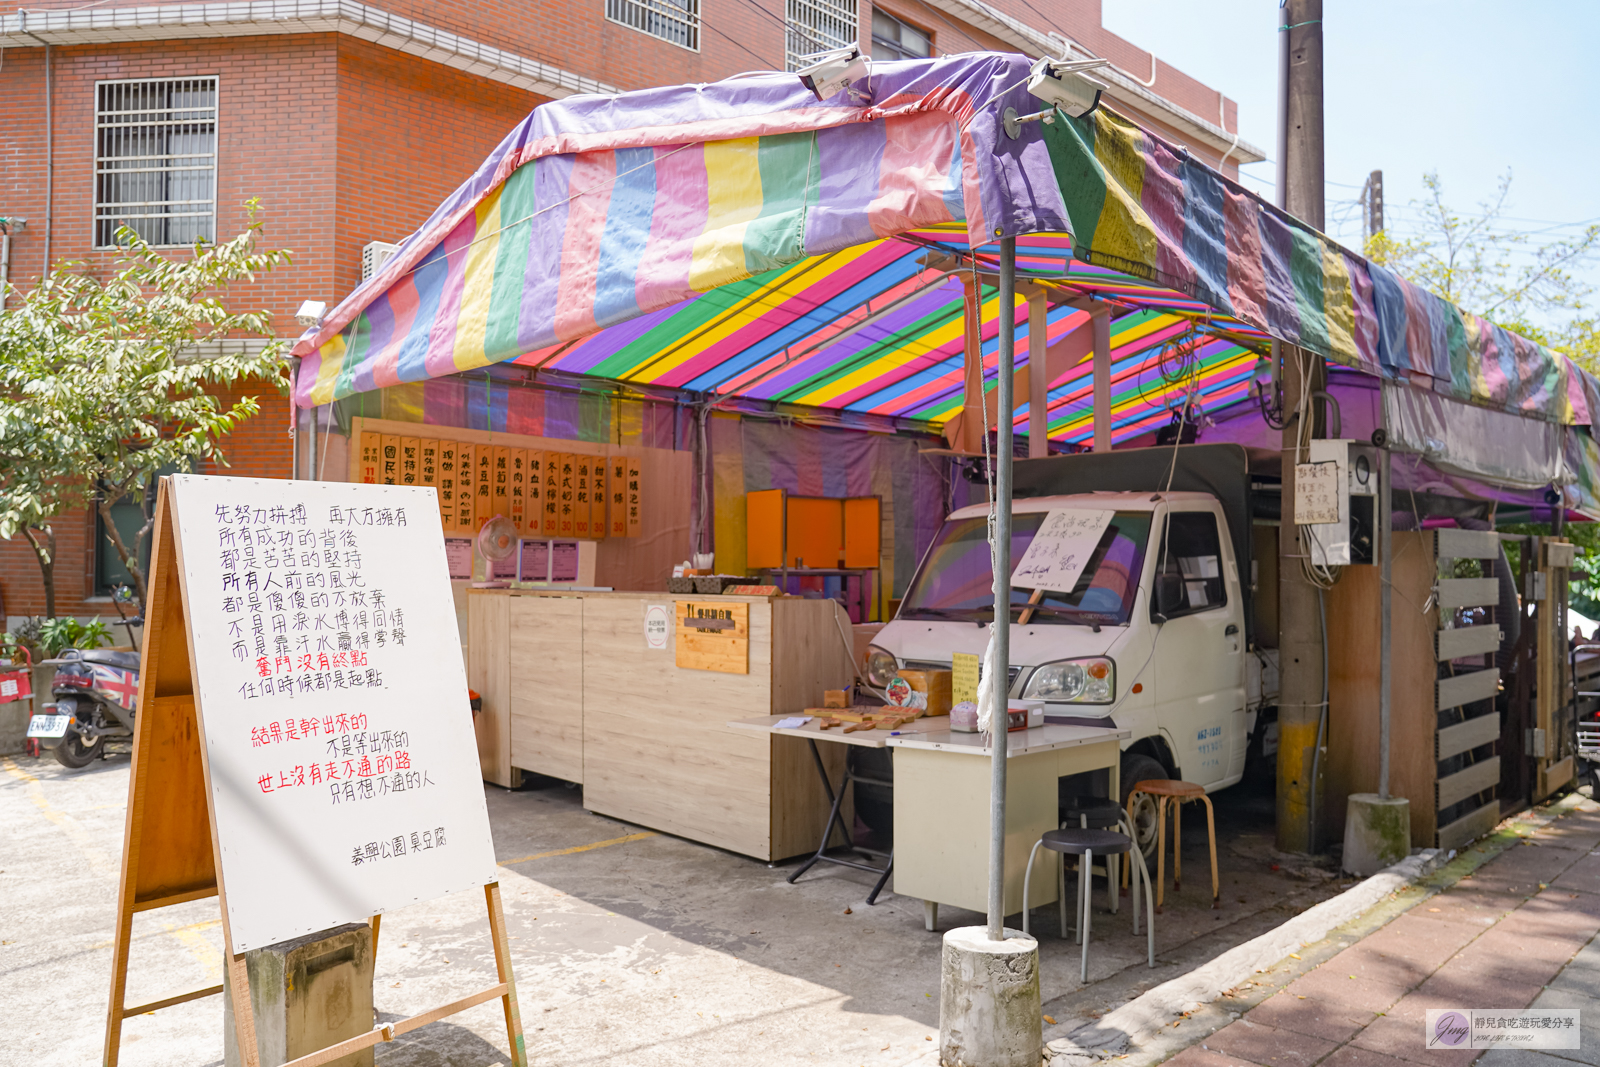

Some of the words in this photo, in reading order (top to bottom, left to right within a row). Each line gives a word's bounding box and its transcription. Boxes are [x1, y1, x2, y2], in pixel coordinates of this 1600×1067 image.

[478, 456, 489, 497] 臭豆腐
[496, 456, 507, 497] 蘿蔔糕
[513, 457, 523, 497] 魯肉飯
[530, 460, 540, 499] 豬血湯
[546, 461, 557, 514] 冬瓜檸檬
[561, 463, 572, 515] 泰式奶茶
[577, 464, 588, 503] 滷豆乾
[594, 466, 604, 504] 甜不辣
[613, 466, 624, 504] 薯條
[215, 502, 308, 526] 先努力拼搏
[329, 506, 407, 528] 再大方擁有
[529, 520, 539, 529] 40
[546, 520, 556, 530] 30
[562, 521, 572, 531] 30
[576, 521, 588, 532] 100
[594, 522, 604, 533] 30
[613, 522, 624, 532] 30
[219, 525, 358, 549] 所有成功的背後
[219, 543, 362, 571] 都是苦苦的堅持
[222, 570, 366, 592] 所有人前的風光
[222, 588, 386, 613] 都是傻傻的不放棄
[228, 607, 404, 638] 不是用淚水博得同情
[232, 628, 407, 662] 而是靠汗水贏得掌聲
[250, 712, 368, 748] 結果是幹出來的
[326, 730, 409, 759] 不是等出來的
[257, 750, 412, 794] 世上沒有走不通的路
[330, 770, 435, 805] 只有想不通的人
